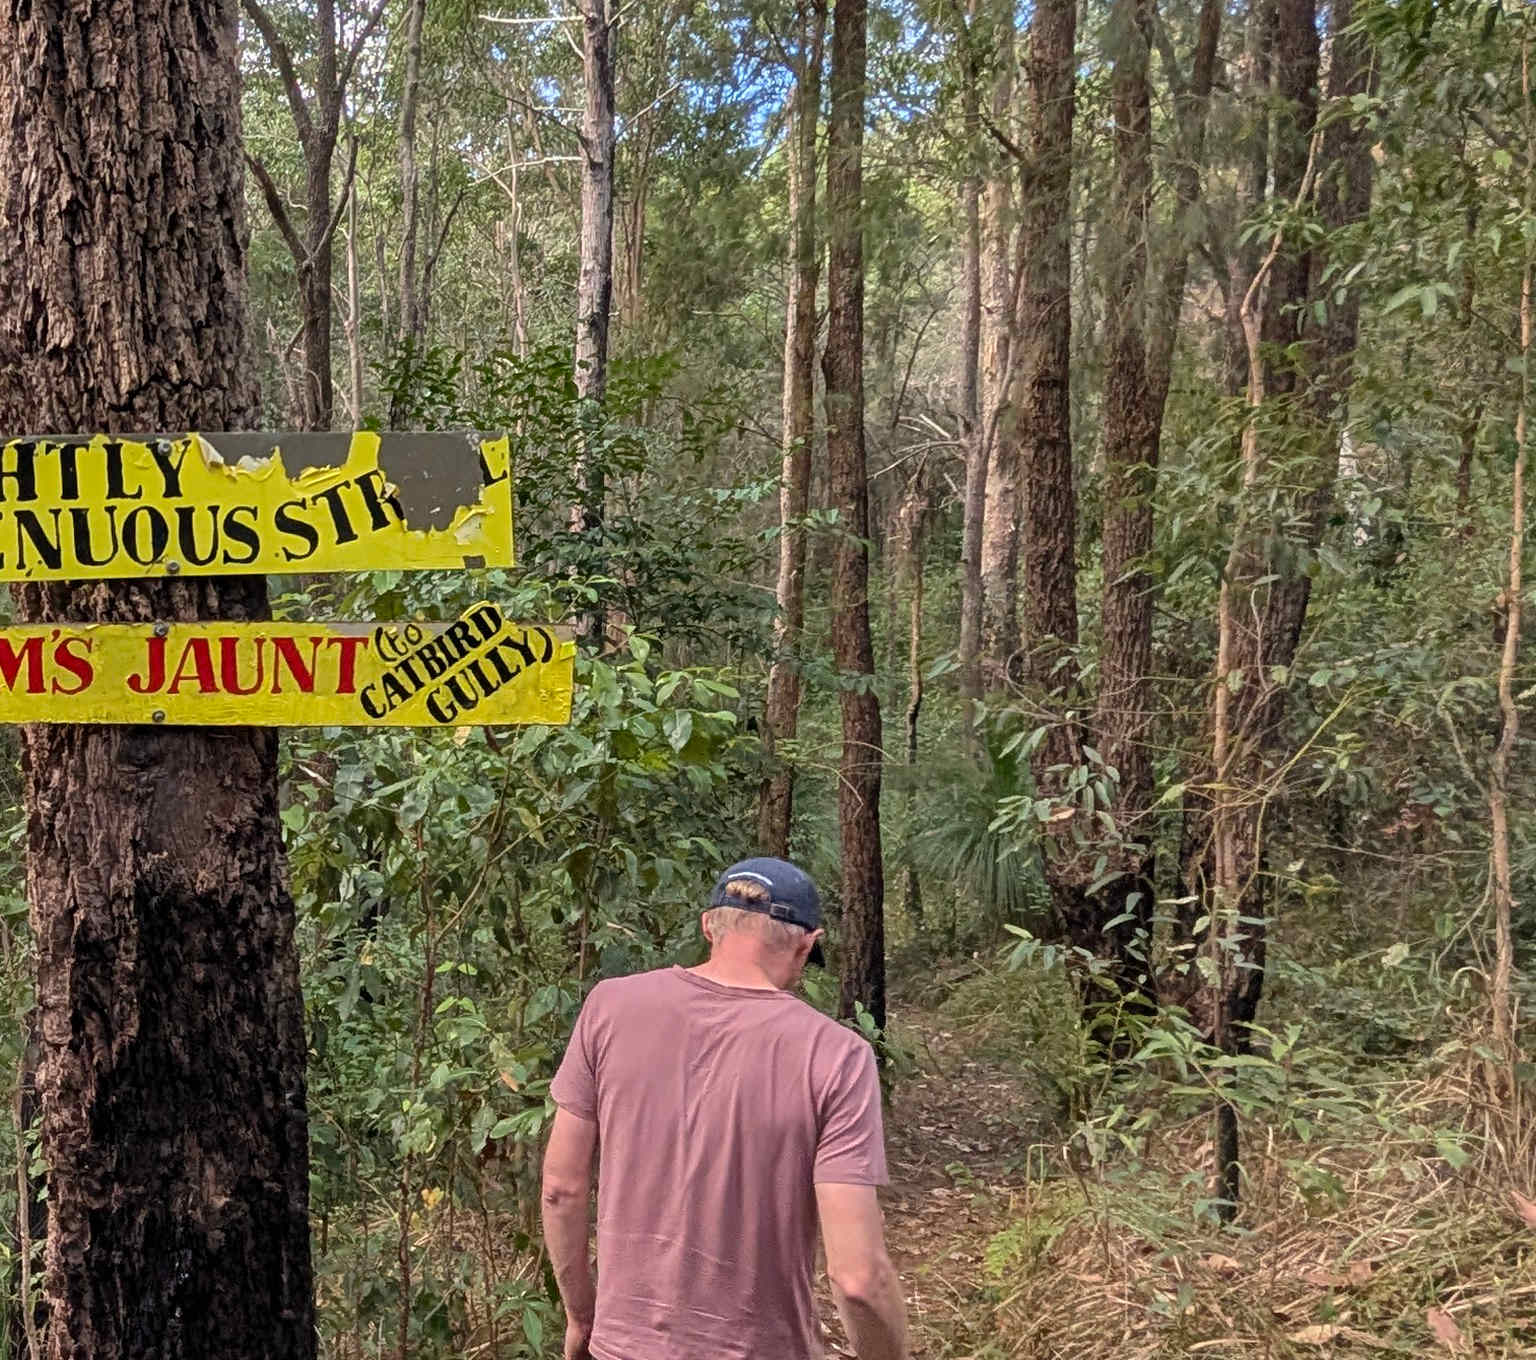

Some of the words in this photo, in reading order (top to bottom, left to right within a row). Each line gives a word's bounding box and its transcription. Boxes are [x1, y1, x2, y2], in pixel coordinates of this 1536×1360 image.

[127, 636, 369, 696] JAUNT
[360, 606, 502, 719] CATBIRD
[375, 624, 422, 661] (to
[426, 627, 553, 724] GULLY)
